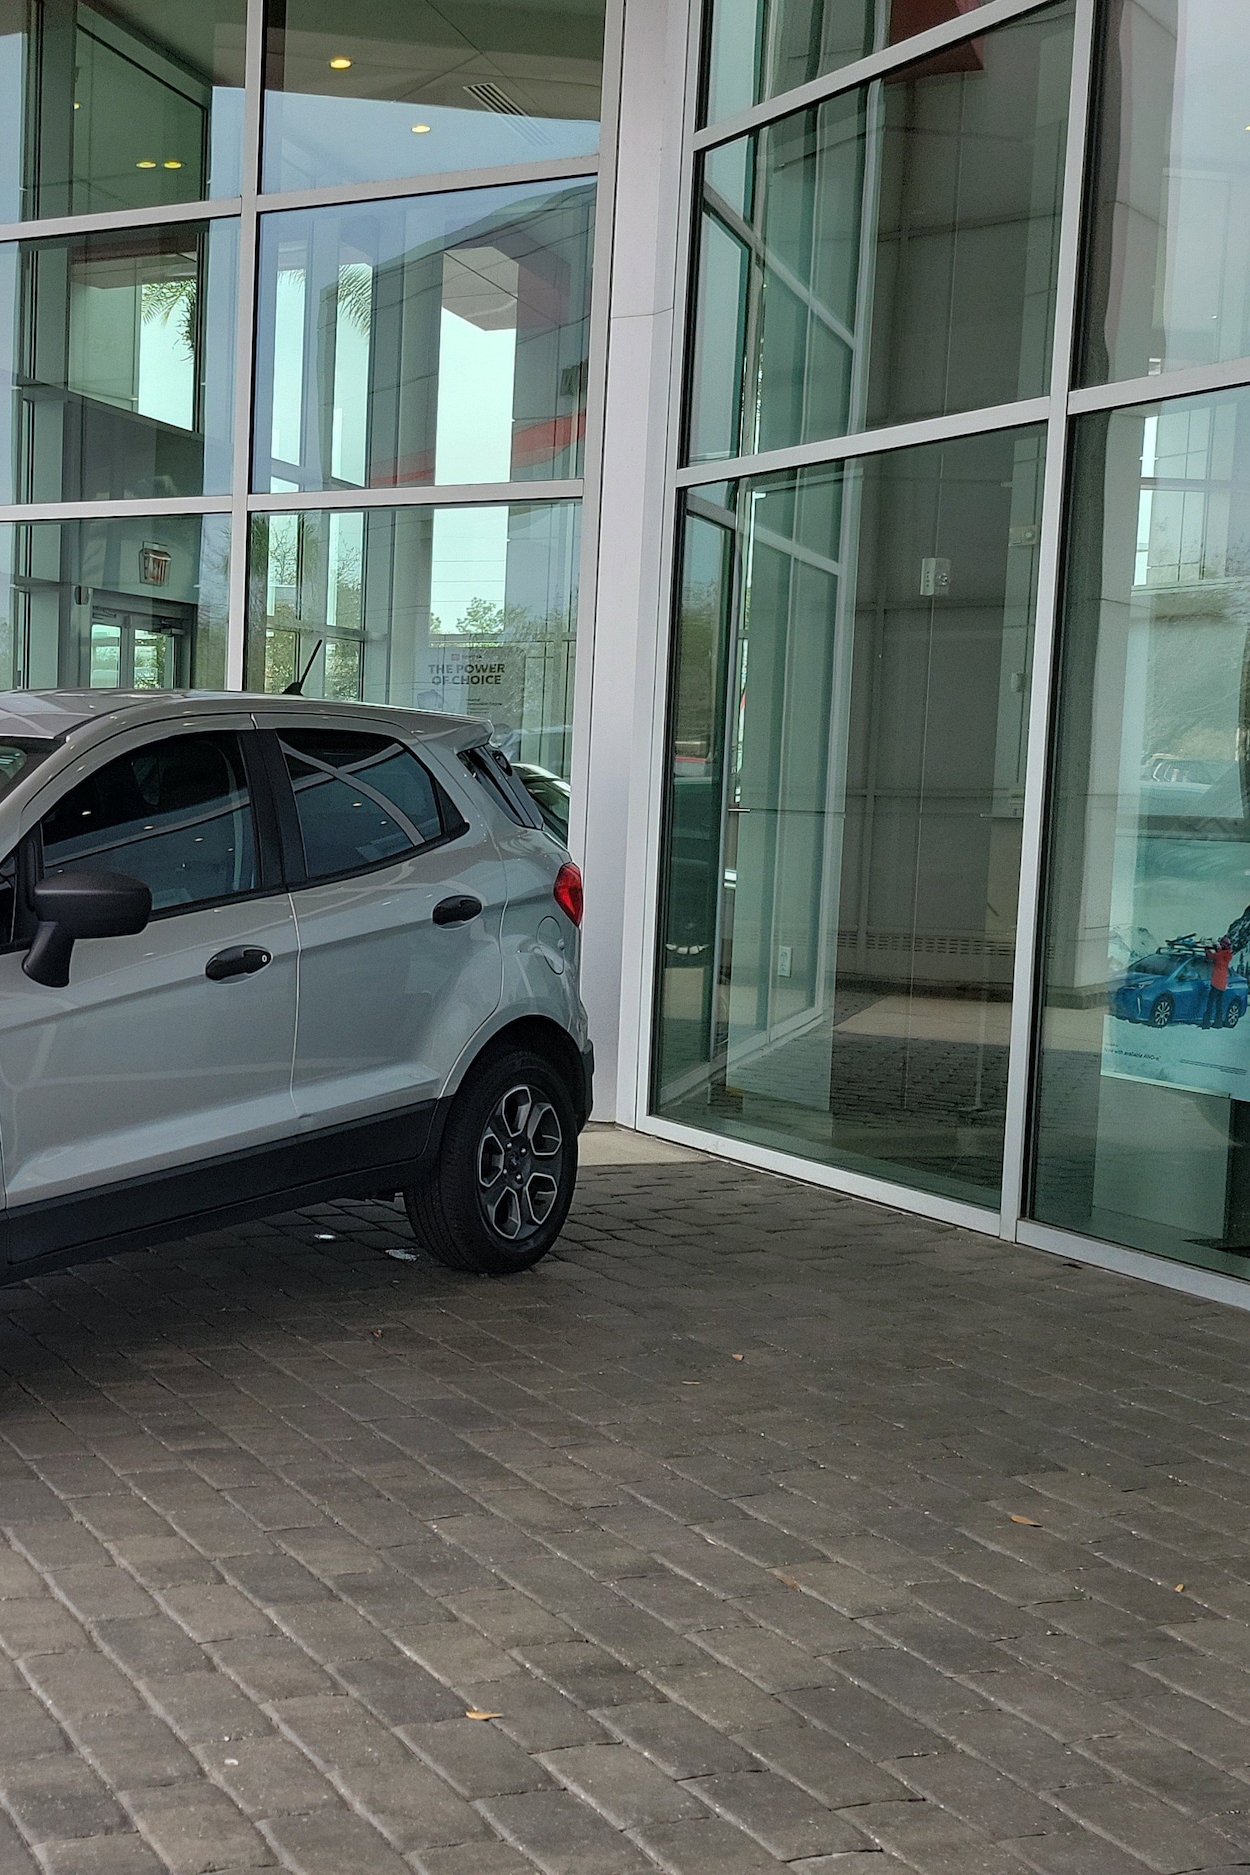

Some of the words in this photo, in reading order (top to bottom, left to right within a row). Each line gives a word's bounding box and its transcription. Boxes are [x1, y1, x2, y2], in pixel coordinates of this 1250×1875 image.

[428, 664, 453, 674] THE
[456, 664, 505, 673] POWER
[432, 676, 449, 685] OF
[452, 675, 501, 684] CHOICE
